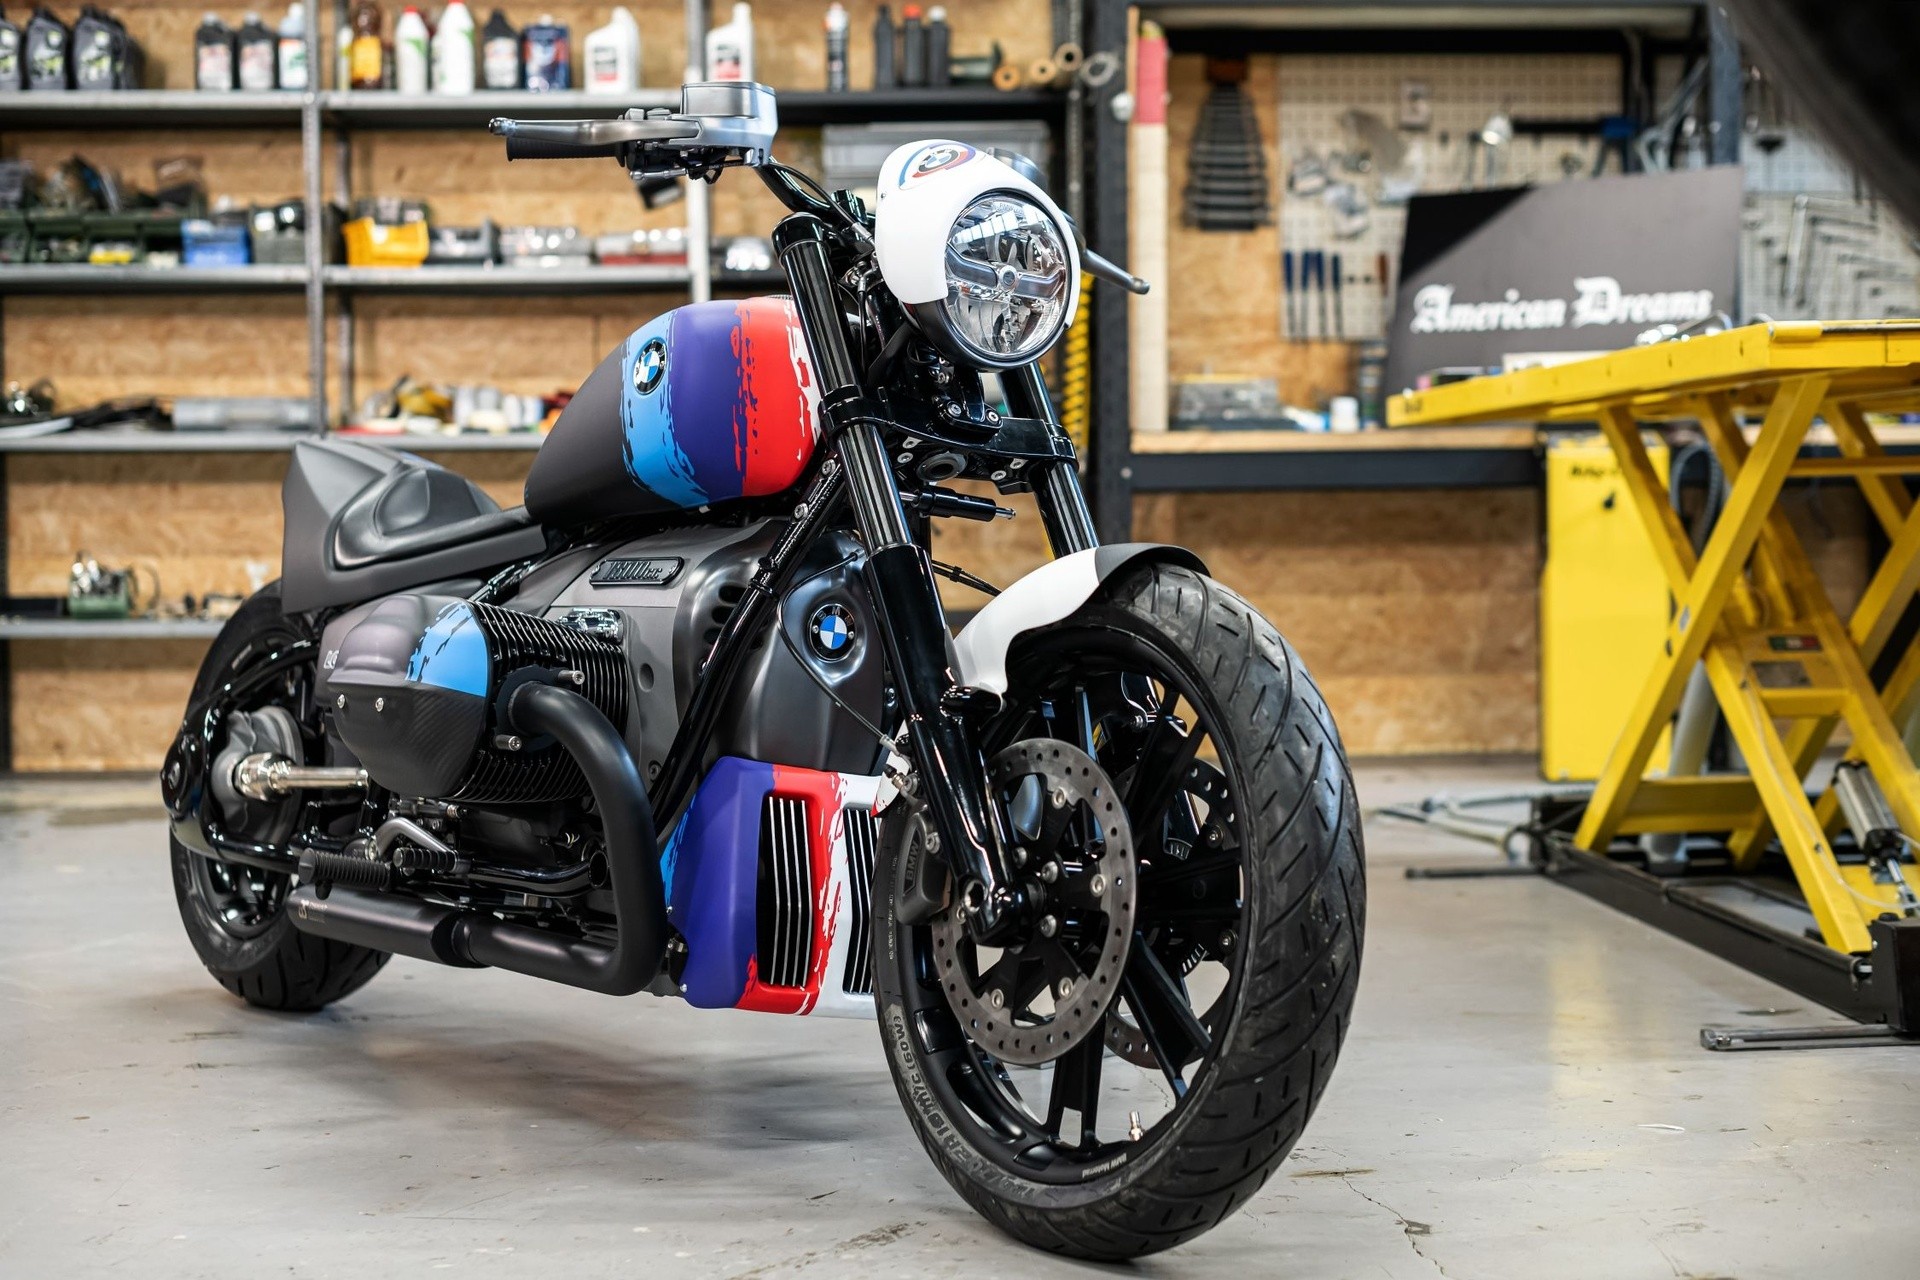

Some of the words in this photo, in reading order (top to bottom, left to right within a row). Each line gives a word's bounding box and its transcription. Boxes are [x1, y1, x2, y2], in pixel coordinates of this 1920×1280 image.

[1410, 284, 1566, 332] American
[1572, 276, 1714, 327] Dreams
[905, 839, 919, 881] BMW
